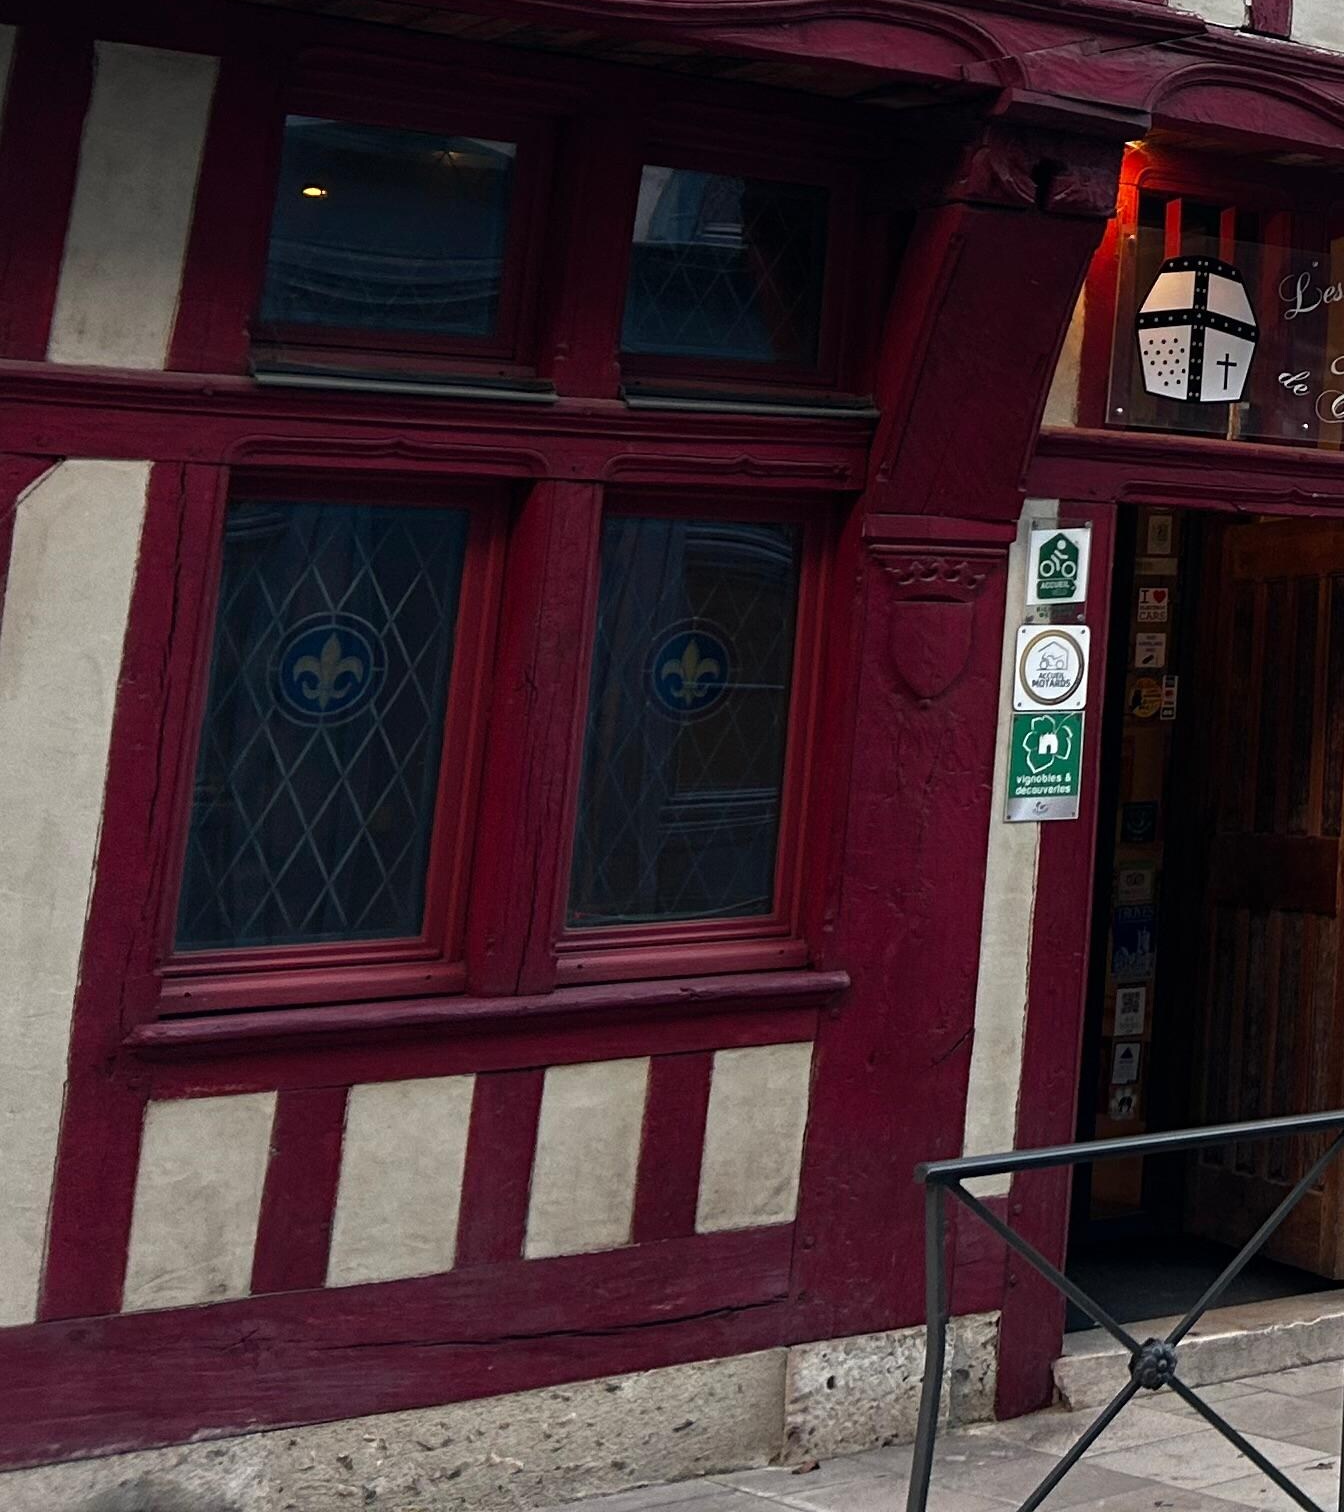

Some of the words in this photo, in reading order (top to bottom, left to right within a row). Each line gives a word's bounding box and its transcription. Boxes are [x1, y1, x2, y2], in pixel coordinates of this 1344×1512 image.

[1278, 370, 1311, 396] de
[1040, 581, 1071, 590] ACCUEIL
[1139, 611, 1166, 621] CARS
[1031, 679, 1071, 688] MOTARDS
[1016, 773, 1062, 786] vignobles
